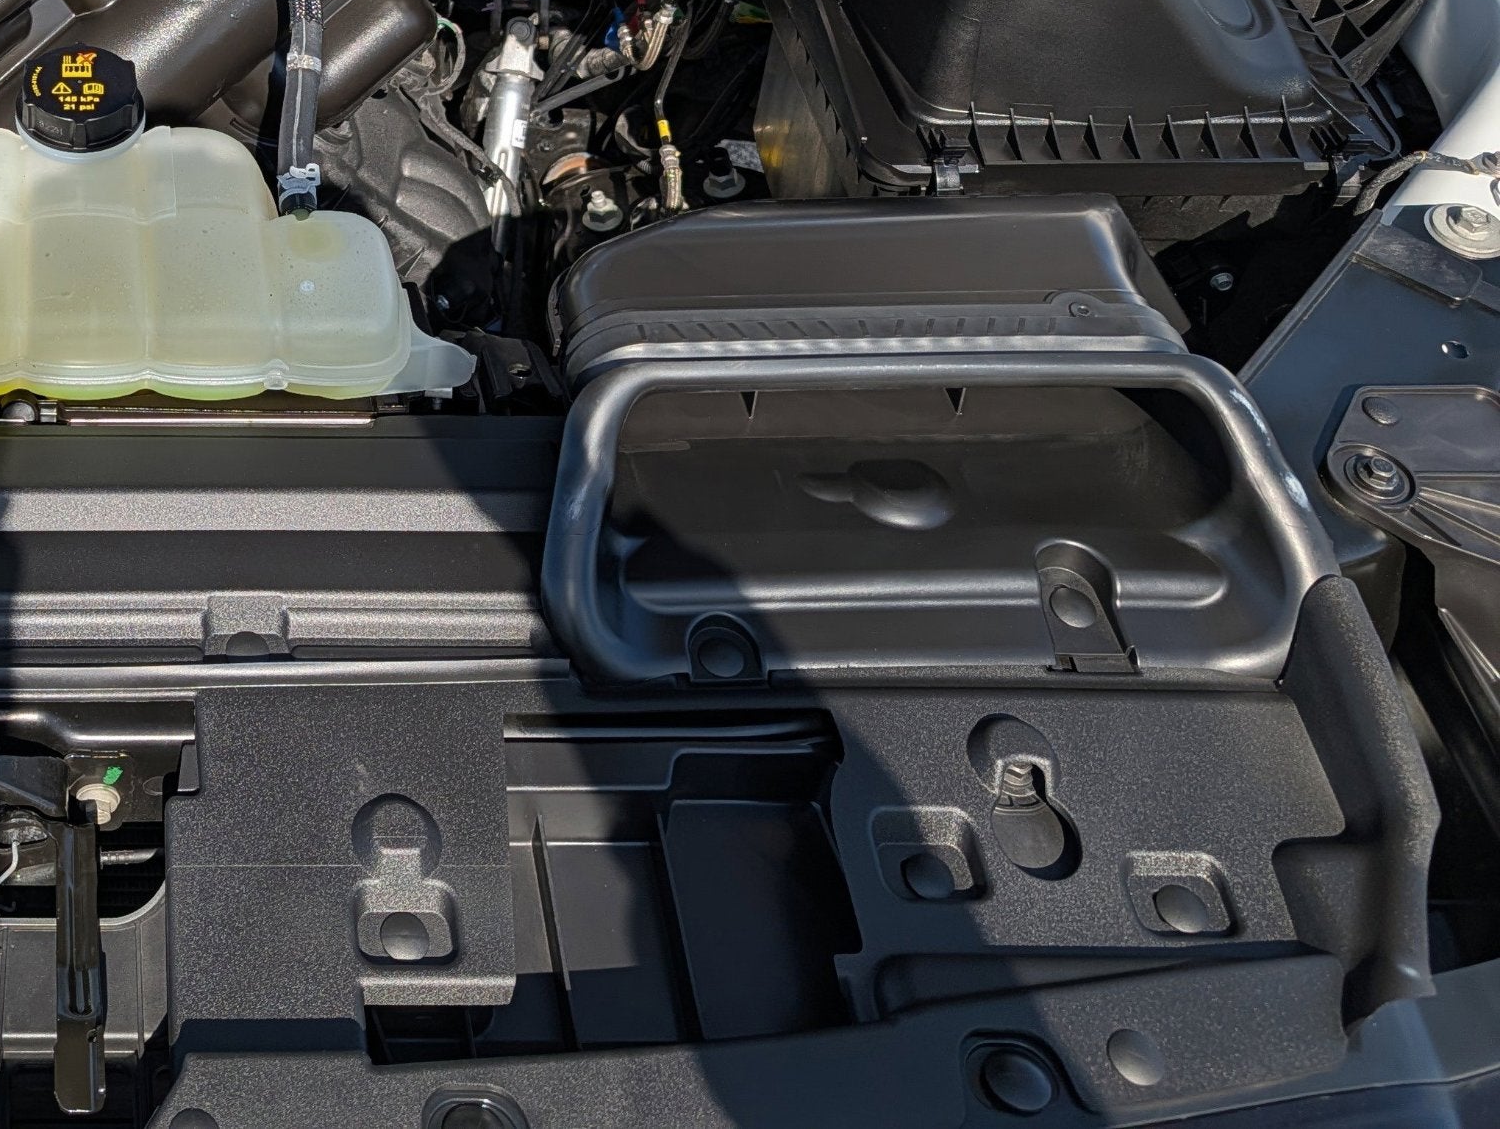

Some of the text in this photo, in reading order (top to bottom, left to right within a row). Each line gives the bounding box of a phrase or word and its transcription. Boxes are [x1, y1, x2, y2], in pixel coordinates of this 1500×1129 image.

[58, 95, 100, 103] 145 kPa
[63, 103, 95, 112] 21 psi
